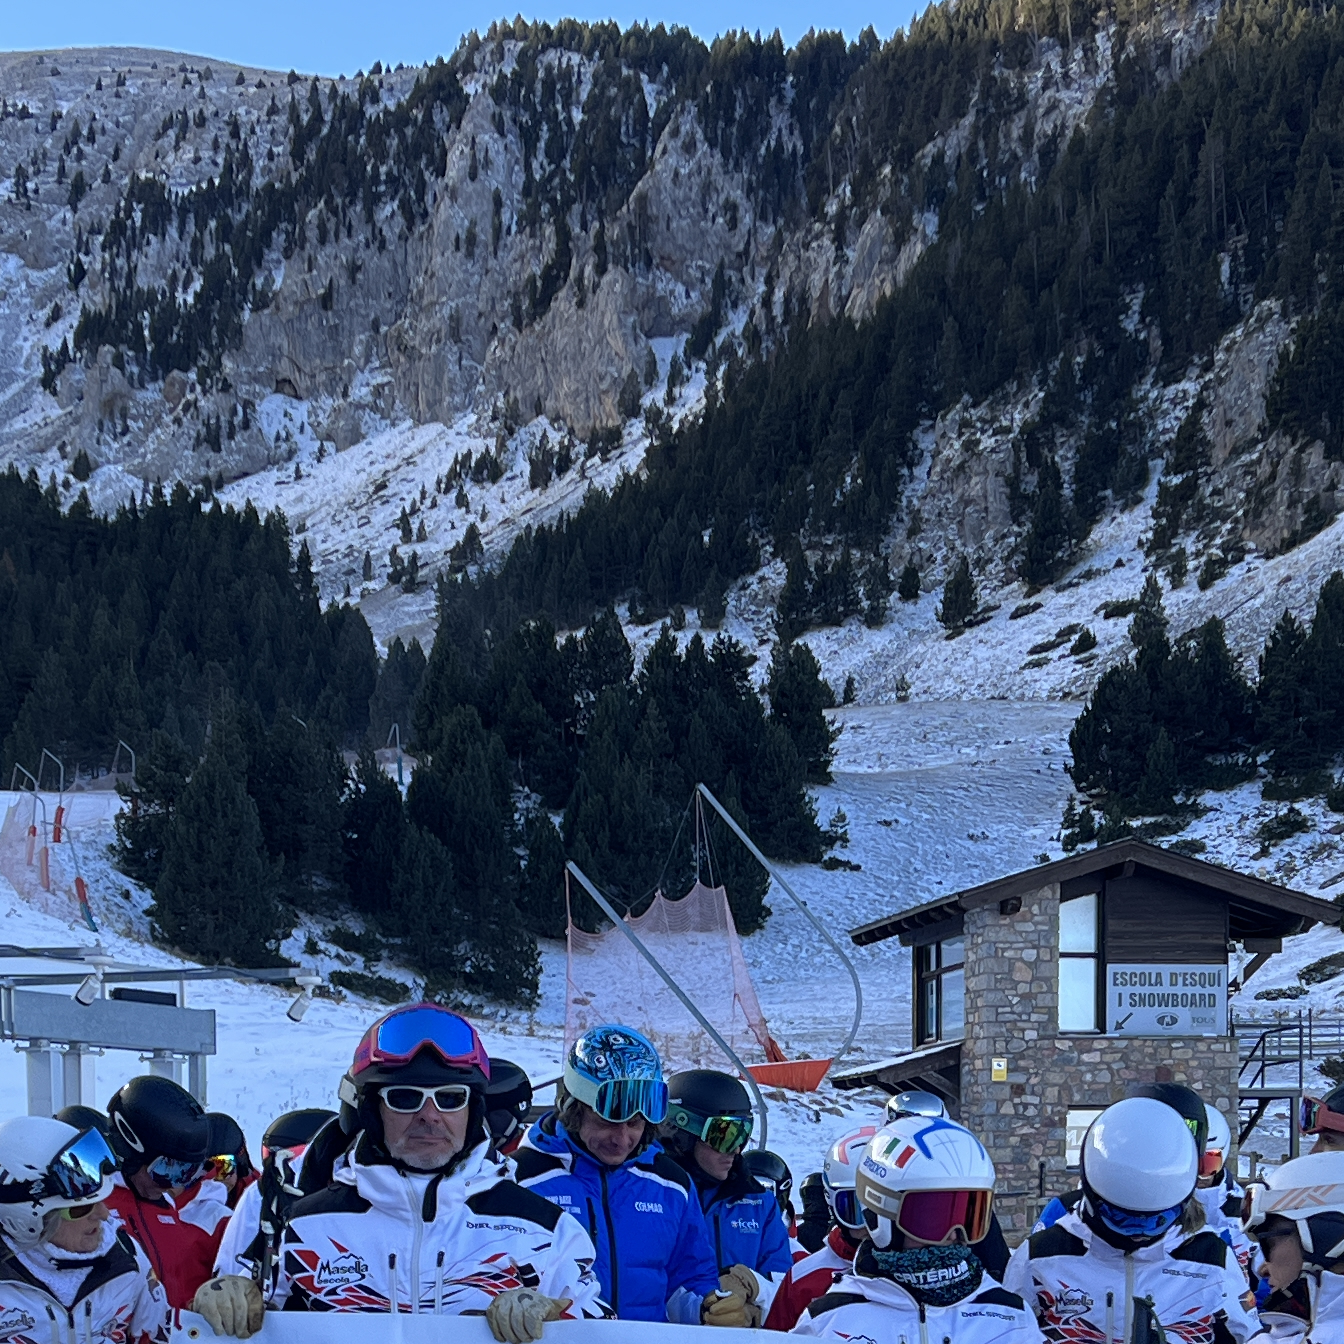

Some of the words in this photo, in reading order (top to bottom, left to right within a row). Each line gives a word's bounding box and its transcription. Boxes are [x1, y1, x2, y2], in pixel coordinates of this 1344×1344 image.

[1112, 971, 1163, 987] ESCOLA
[1169, 969, 1222, 989] D'ESQUÍ
[1117, 992, 1123, 1008] I
[1129, 992, 1216, 1008] SNOWBOARD
[318, 1258, 369, 1275] Masella
